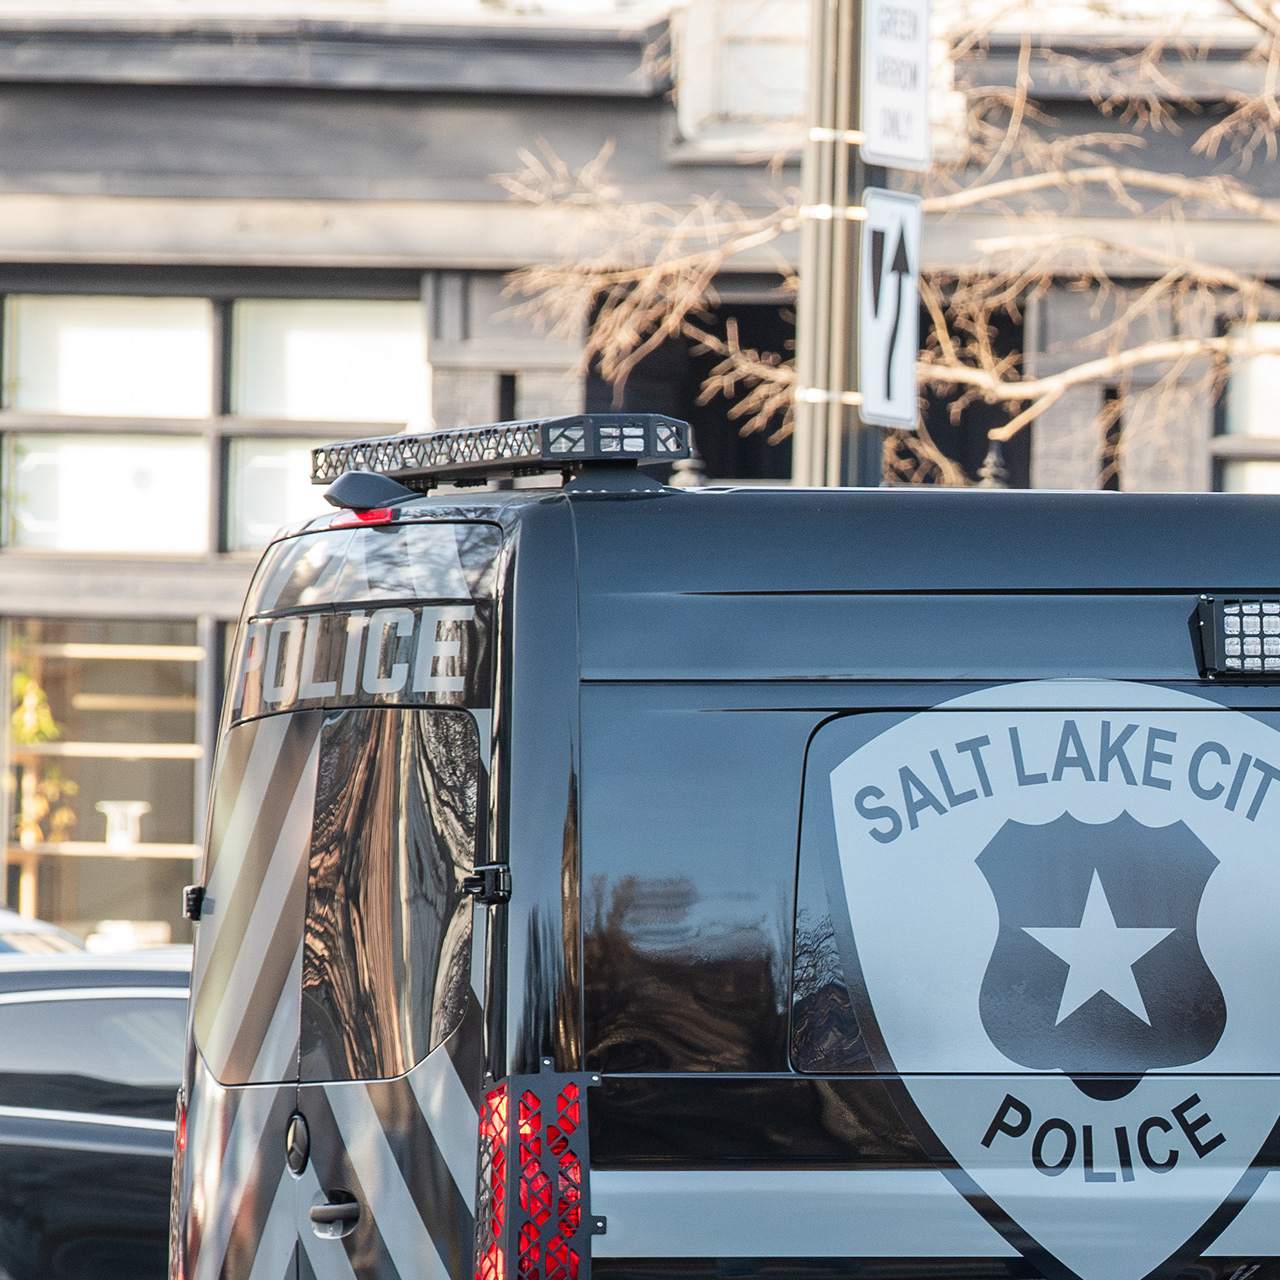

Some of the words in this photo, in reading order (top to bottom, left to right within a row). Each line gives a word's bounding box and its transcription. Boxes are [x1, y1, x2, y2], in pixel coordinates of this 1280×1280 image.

[233, 605, 475, 710] POLICE
[854, 735, 995, 845] SALT
[1008, 720, 1178, 791] LAKE
[980, 1093, 1227, 1183] POLICE
